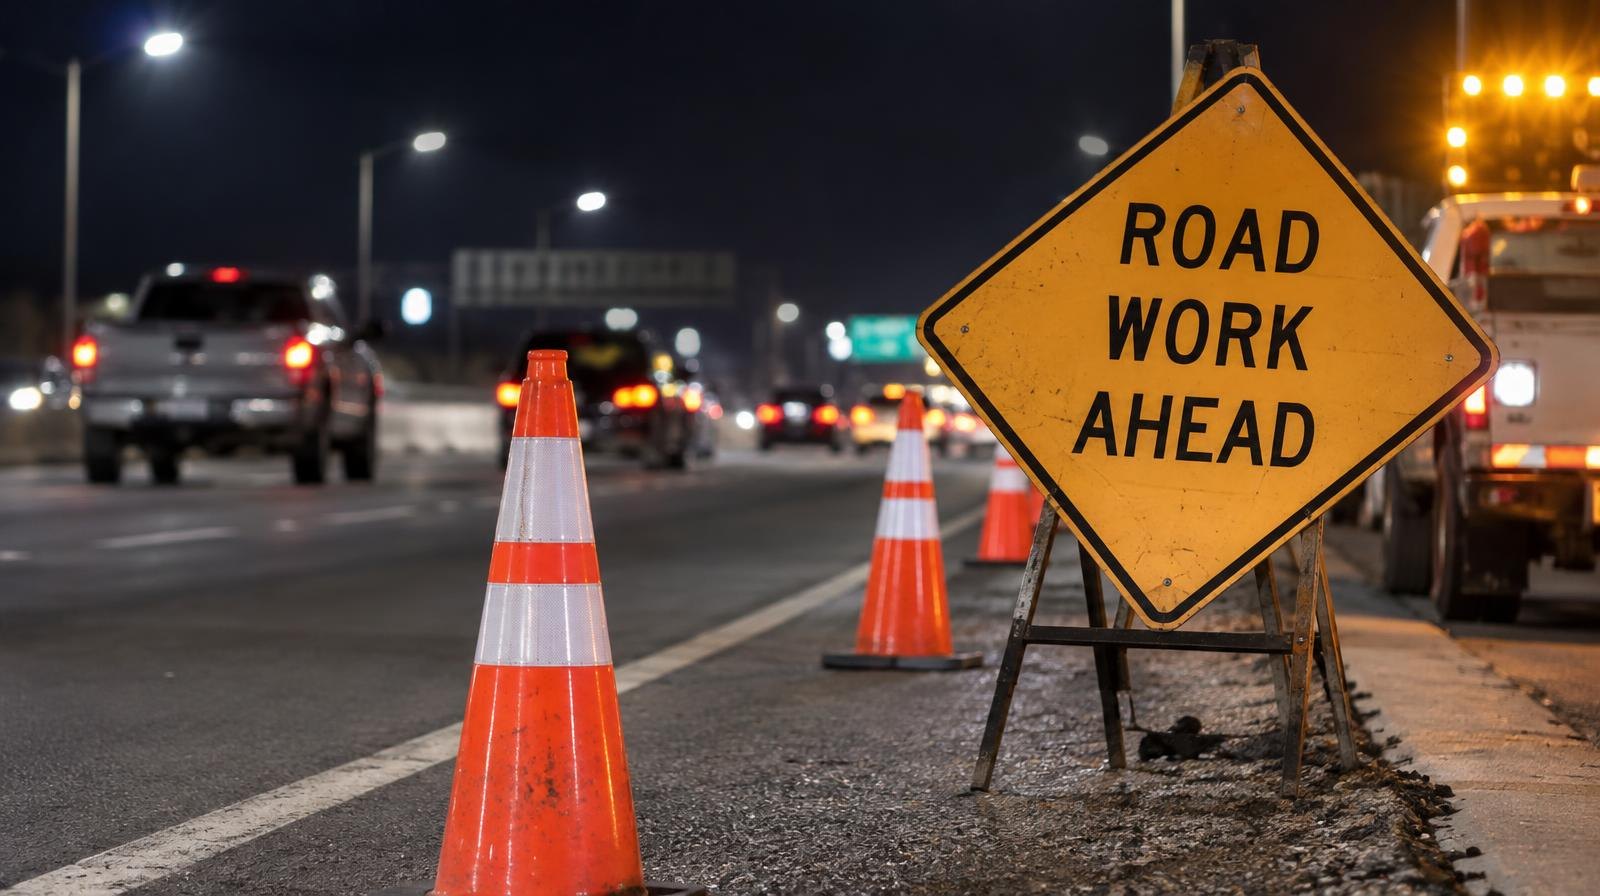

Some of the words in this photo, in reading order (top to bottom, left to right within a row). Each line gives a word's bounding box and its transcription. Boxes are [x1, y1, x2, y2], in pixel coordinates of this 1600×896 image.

[1120, 202, 1320, 274] ROAD
[1108, 296, 1314, 371] WORK
[1072, 391, 1315, 468] AHEAD
